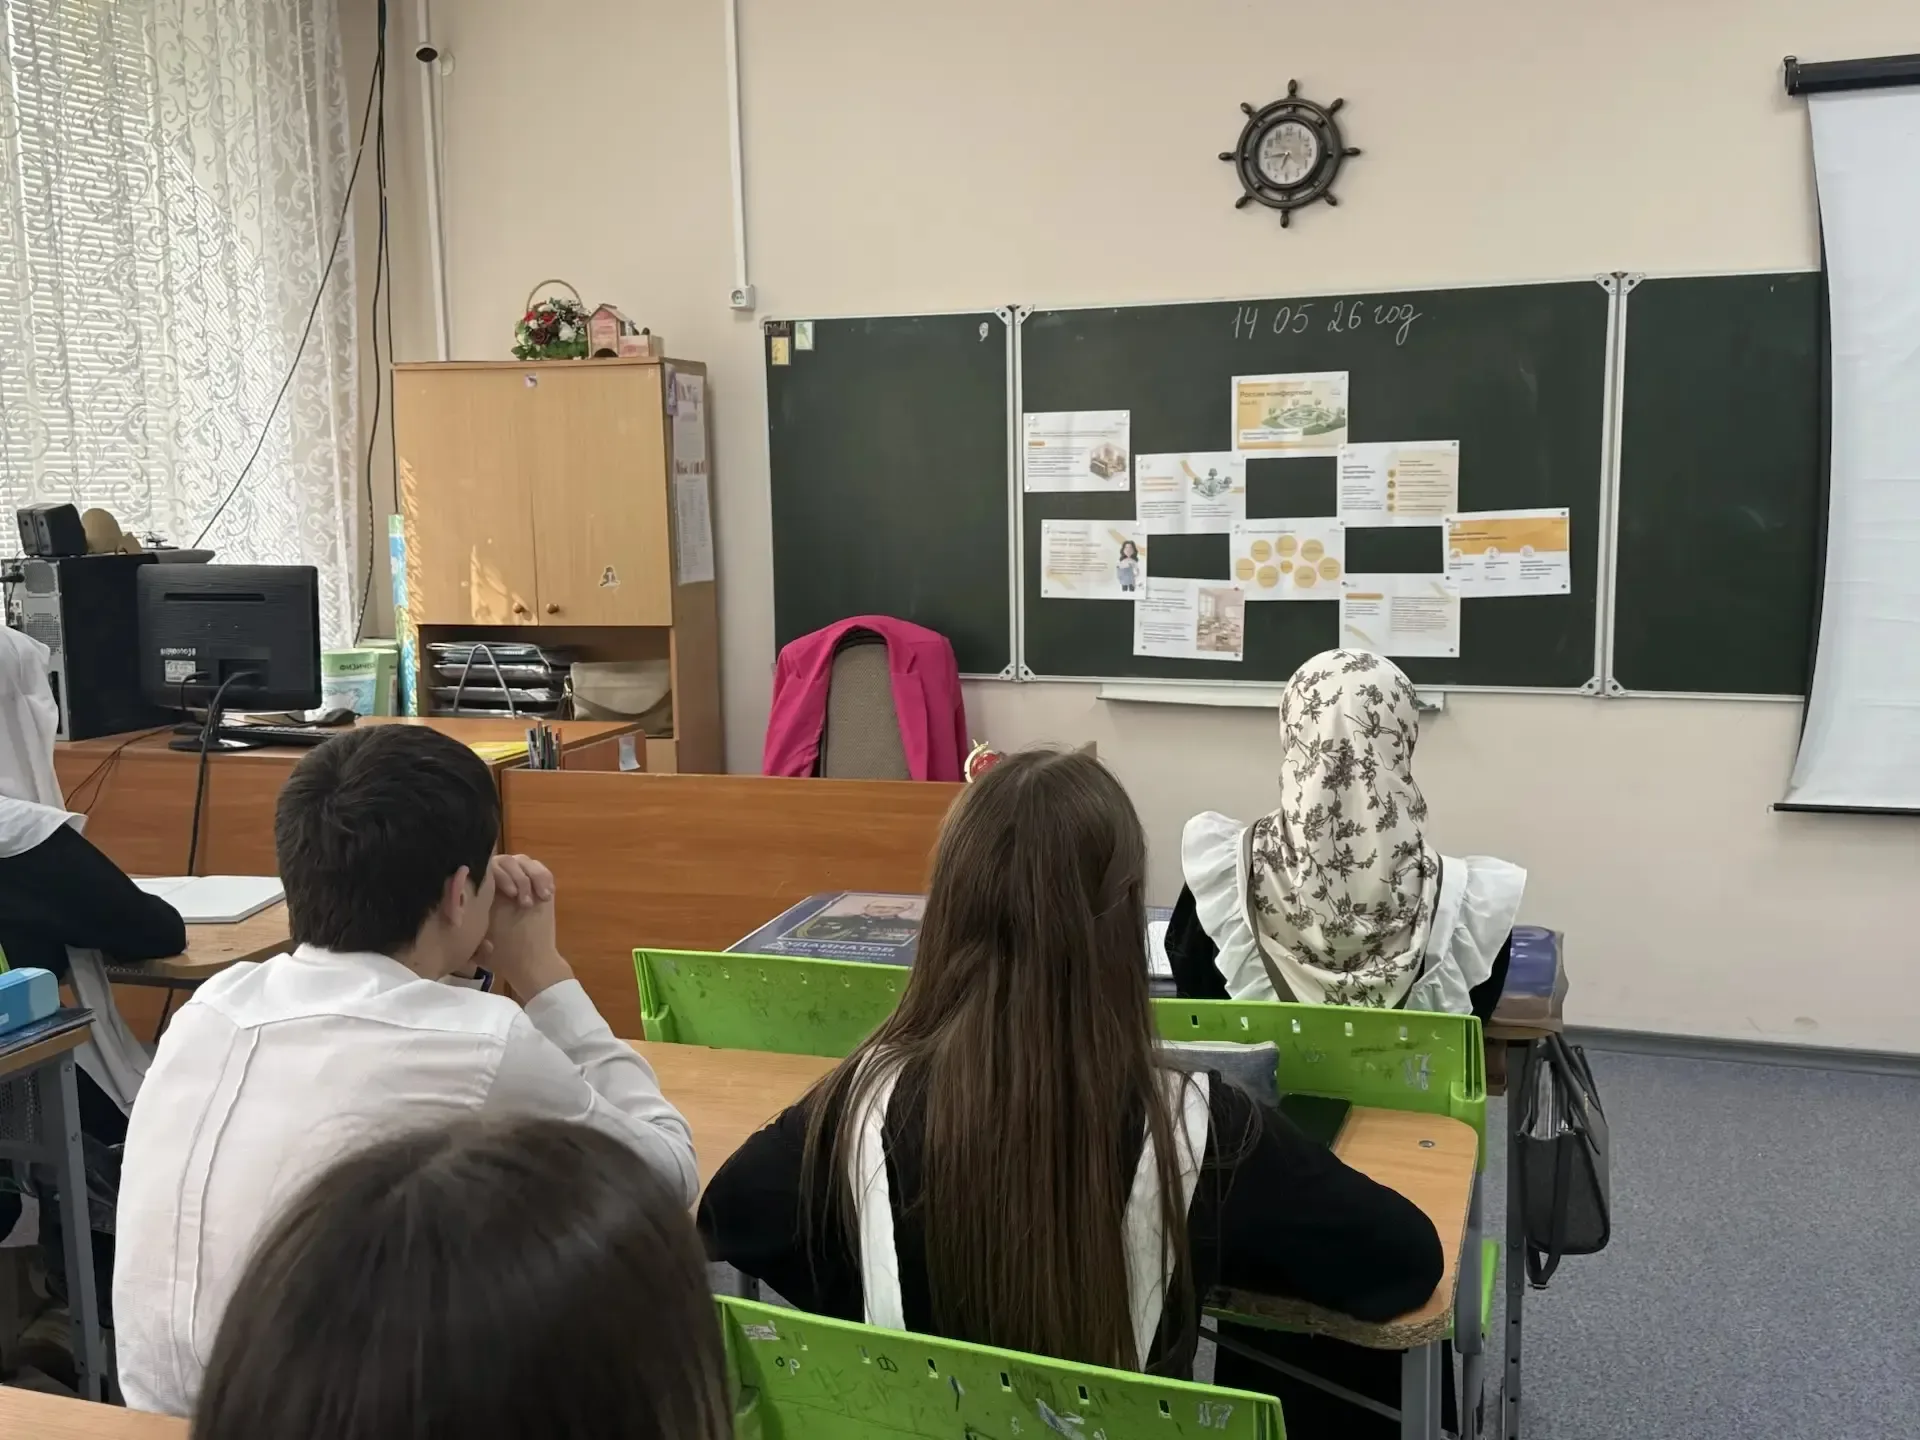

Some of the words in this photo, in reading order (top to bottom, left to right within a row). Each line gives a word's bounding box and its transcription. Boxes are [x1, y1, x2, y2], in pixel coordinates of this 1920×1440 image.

[1231, 306, 1259, 340] 14
[1273, 303, 1315, 334] 05
[1327, 300, 1364, 333] 26
[1374, 303, 1423, 346] год
